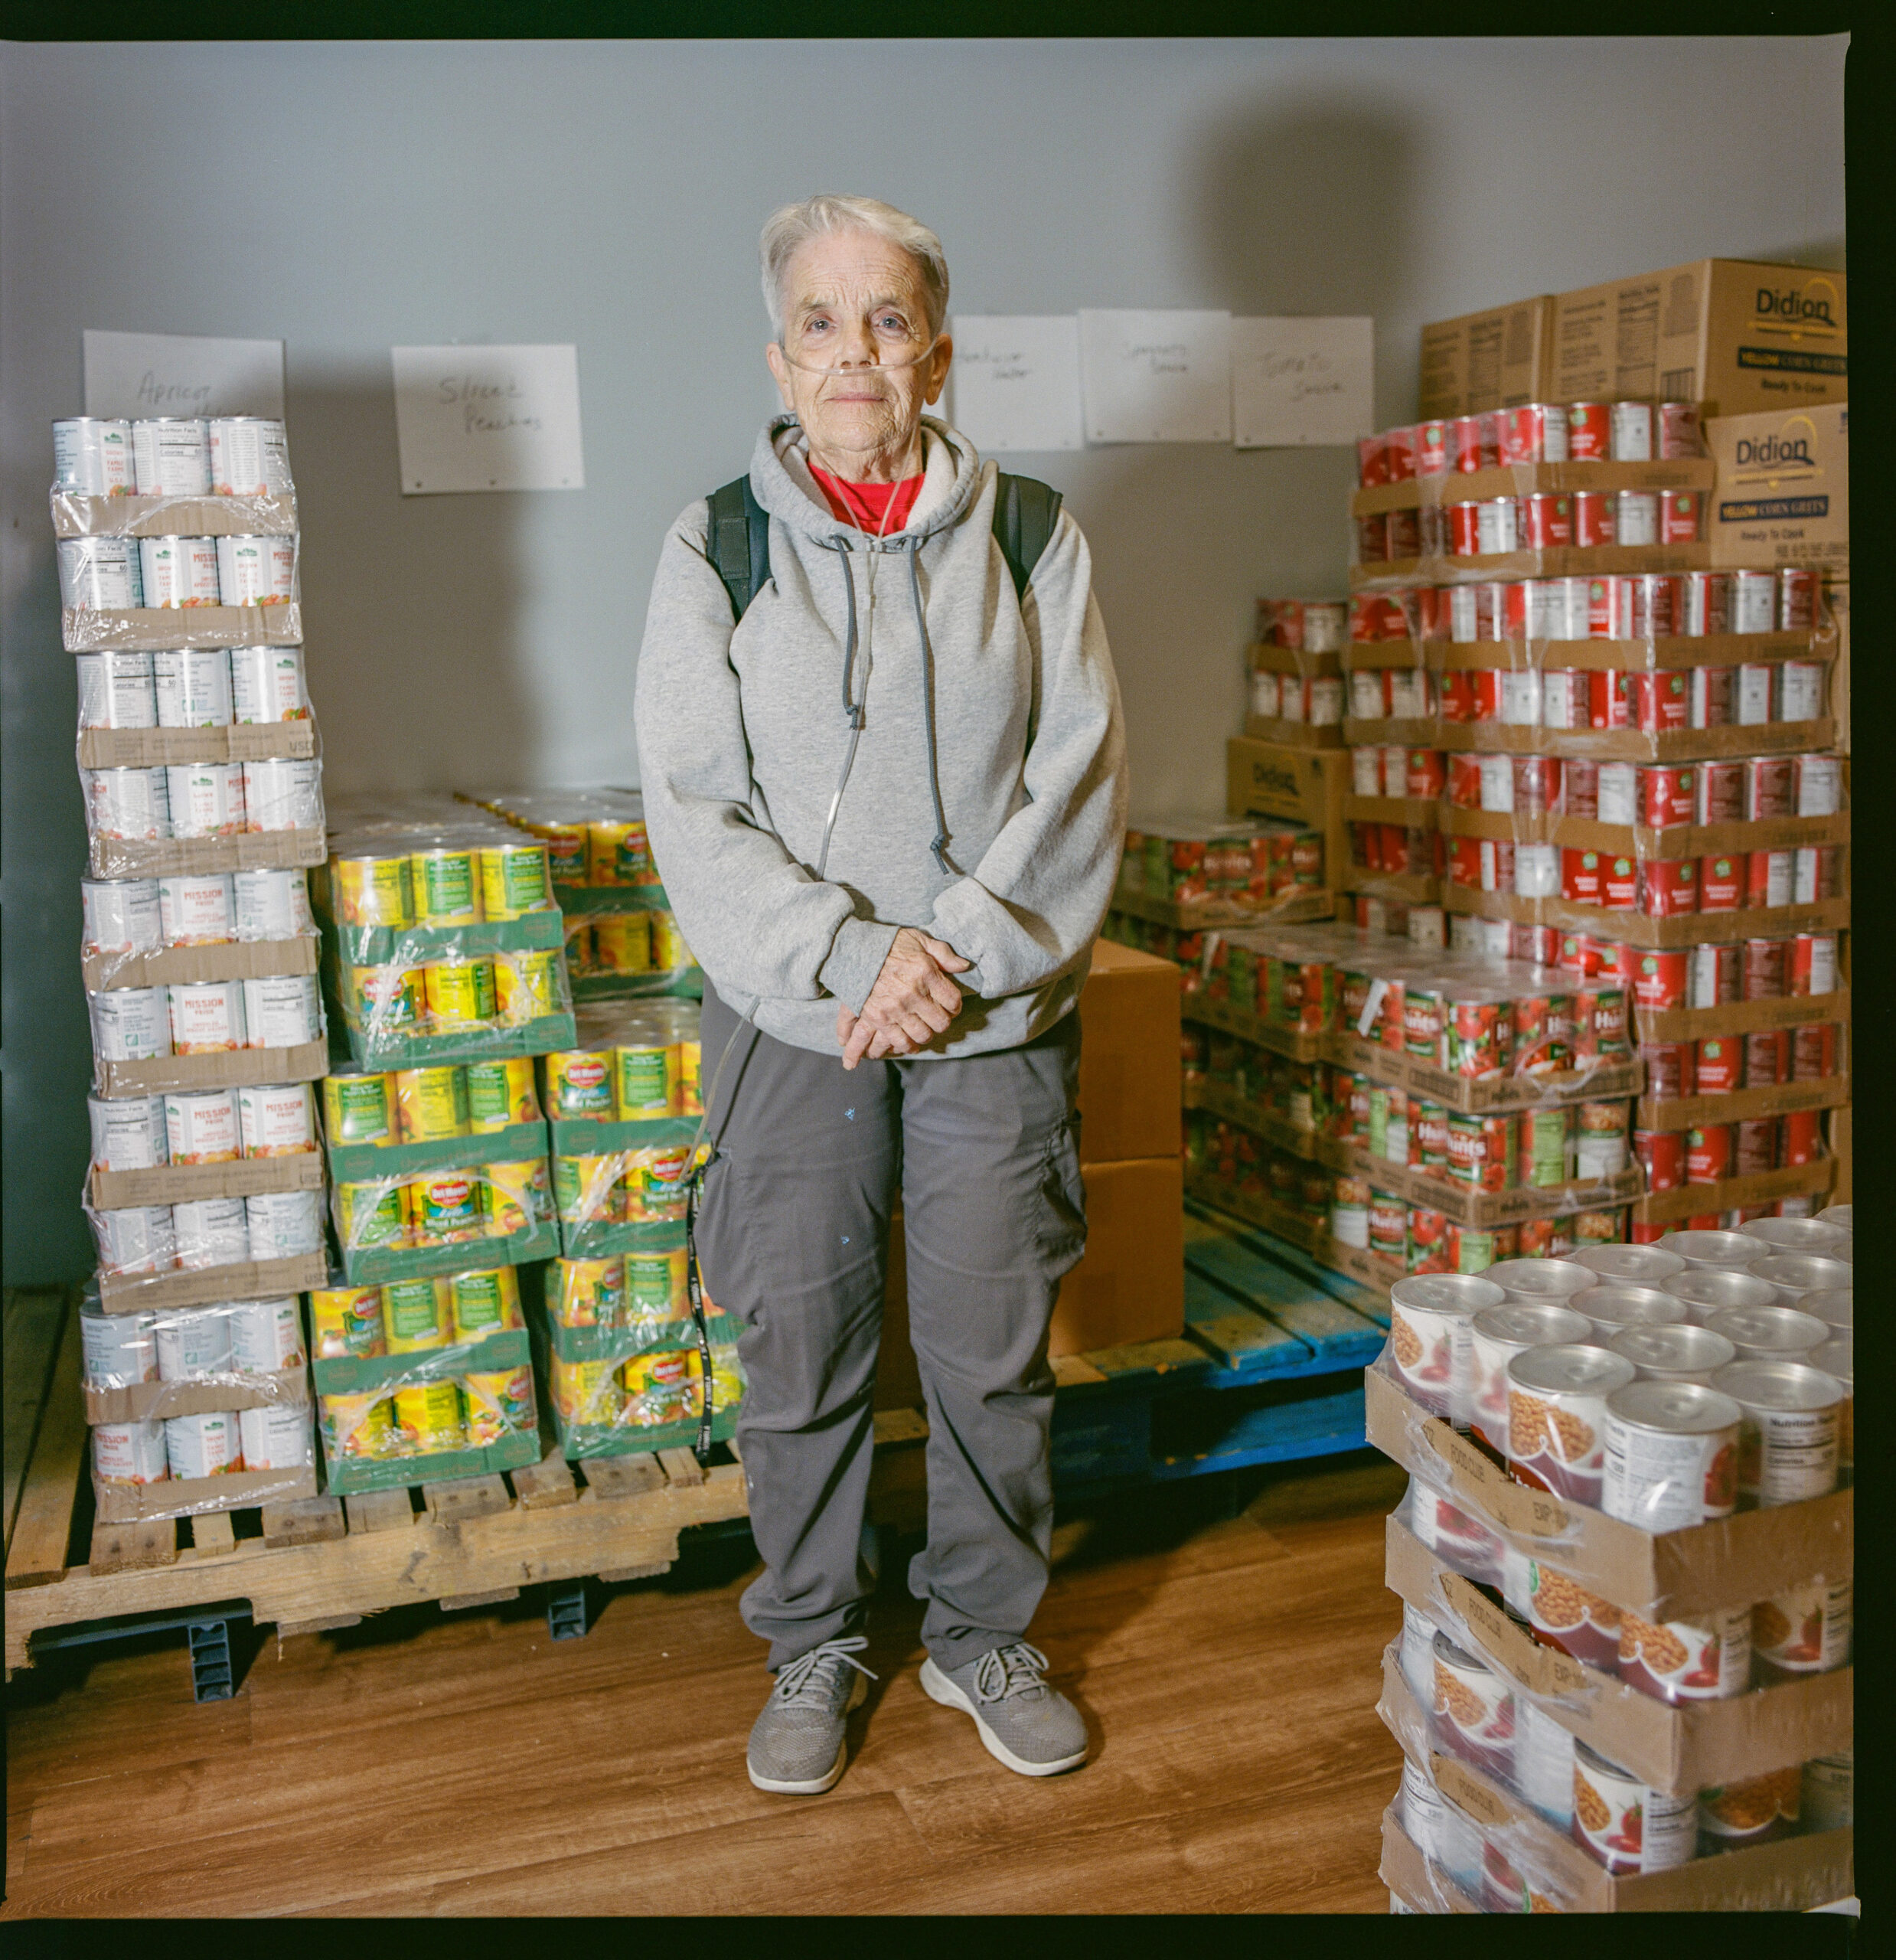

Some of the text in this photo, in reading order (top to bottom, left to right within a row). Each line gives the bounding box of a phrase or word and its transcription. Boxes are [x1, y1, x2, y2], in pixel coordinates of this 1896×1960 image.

[1756, 288, 1836, 327] Didion
[1763, 379, 1789, 393] Ready
[1737, 434, 1815, 466] Didion
[1741, 529, 1767, 543] Ready
[1783, 526, 1804, 540] Cook
[184, 889, 223, 900] MISSION
[185, 998, 224, 1008] MISSION
[266, 1099, 303, 1112] MISSION
[194, 1106, 231, 1119] MISSION
[431, 1184, 468, 1199] Del Monte
[1770, 1418, 1816, 1428] Nutrition
[1768, 1456, 1804, 1465] Calories
